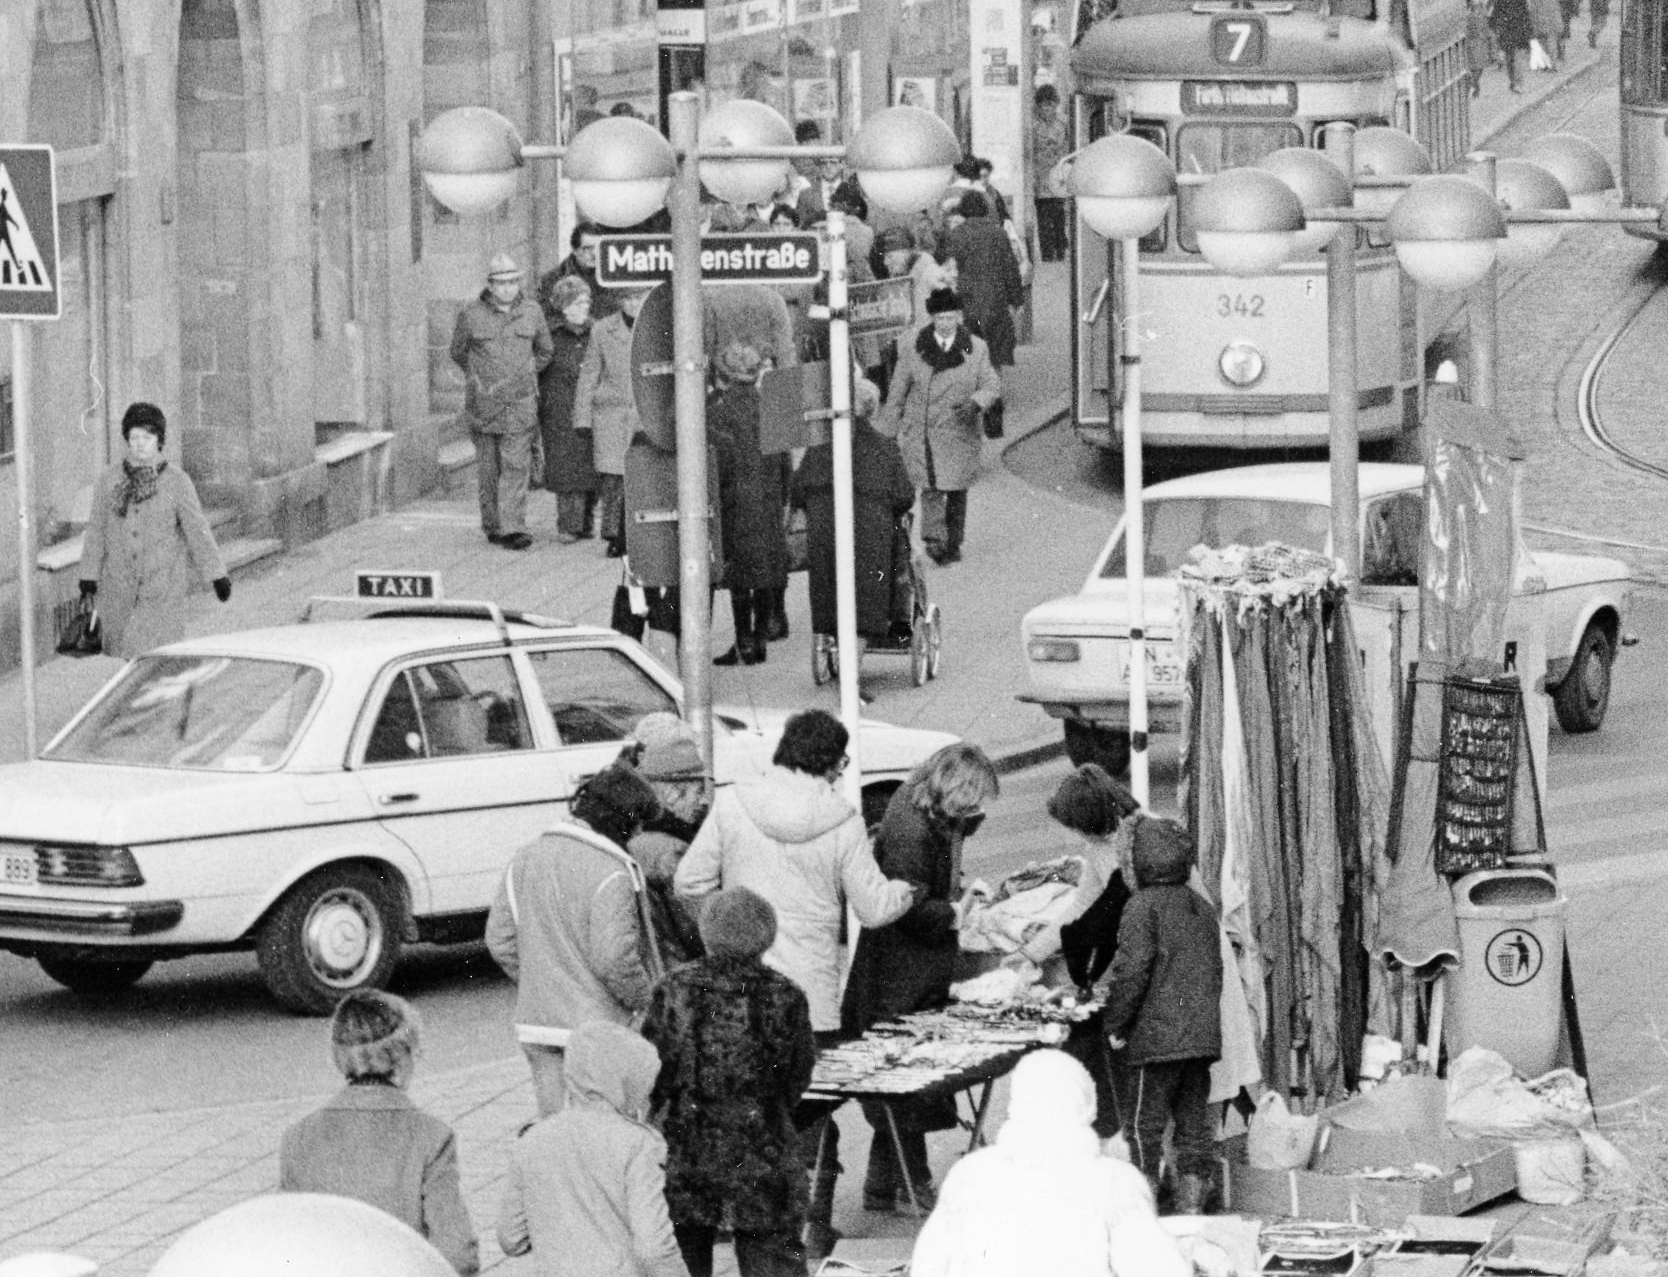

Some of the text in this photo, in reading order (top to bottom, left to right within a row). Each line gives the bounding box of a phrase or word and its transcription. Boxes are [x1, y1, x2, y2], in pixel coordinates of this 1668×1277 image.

[1227, 23, 1253, 62] 7
[608, 241, 811, 274] Mathenstraße
[1217, 293, 1266, 318] 342
[367, 577, 423, 596] TAXI
